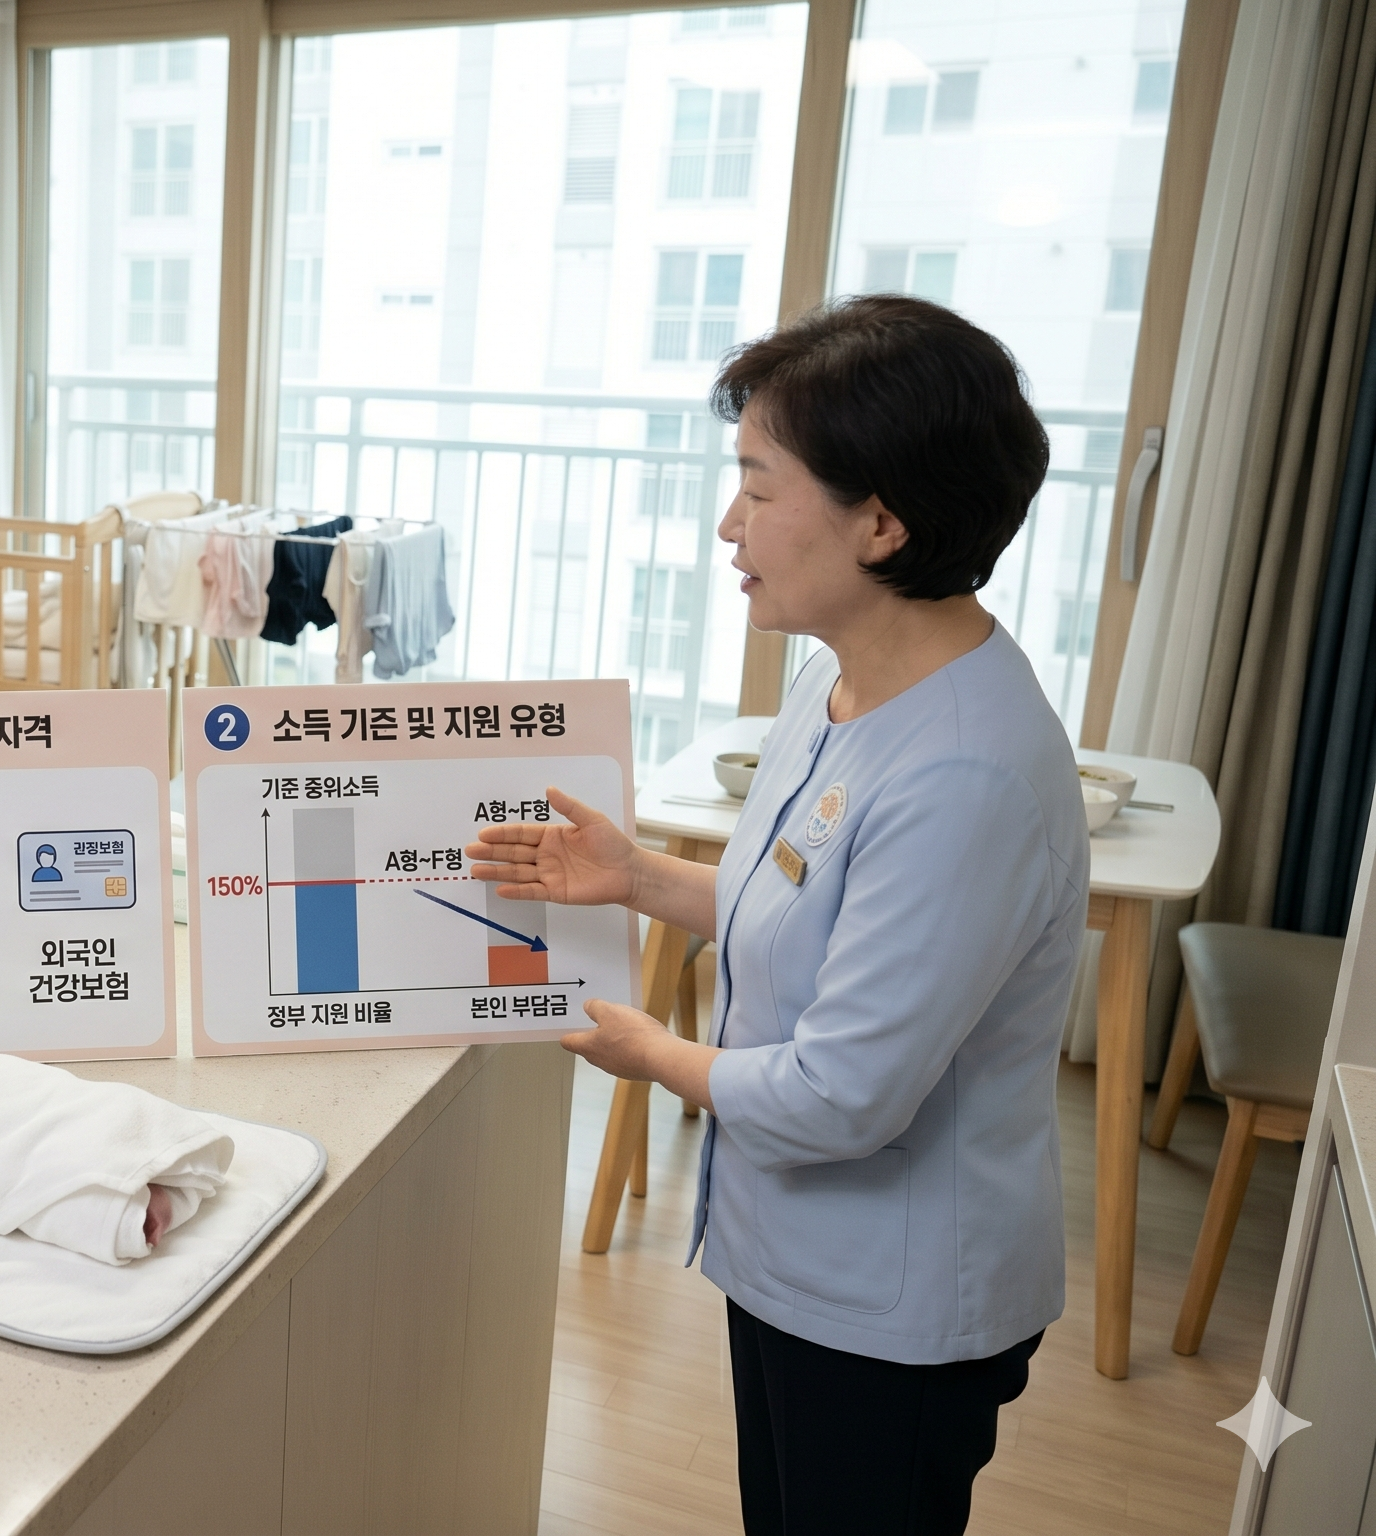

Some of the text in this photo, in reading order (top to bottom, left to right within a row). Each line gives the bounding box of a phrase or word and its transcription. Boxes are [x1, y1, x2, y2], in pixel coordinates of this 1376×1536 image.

[217, 712, 237, 743] 2
[273, 708, 332, 743] 소득
[407, 706, 436, 740] 및
[443, 704, 501, 739] 지원
[509, 702, 566, 738] 유형
[261, 775, 380, 800] 기준 중위소득
[473, 799, 550, 823] A형~F형
[384, 847, 463, 873] A형~F형
[207, 875, 264, 897] 150%
[40, 938, 116, 968] 외국인
[29, 970, 129, 1004] 건강보험
[267, 1000, 392, 1029] 정부 지원 비율
[470, 994, 569, 1019] 본인 부담금
